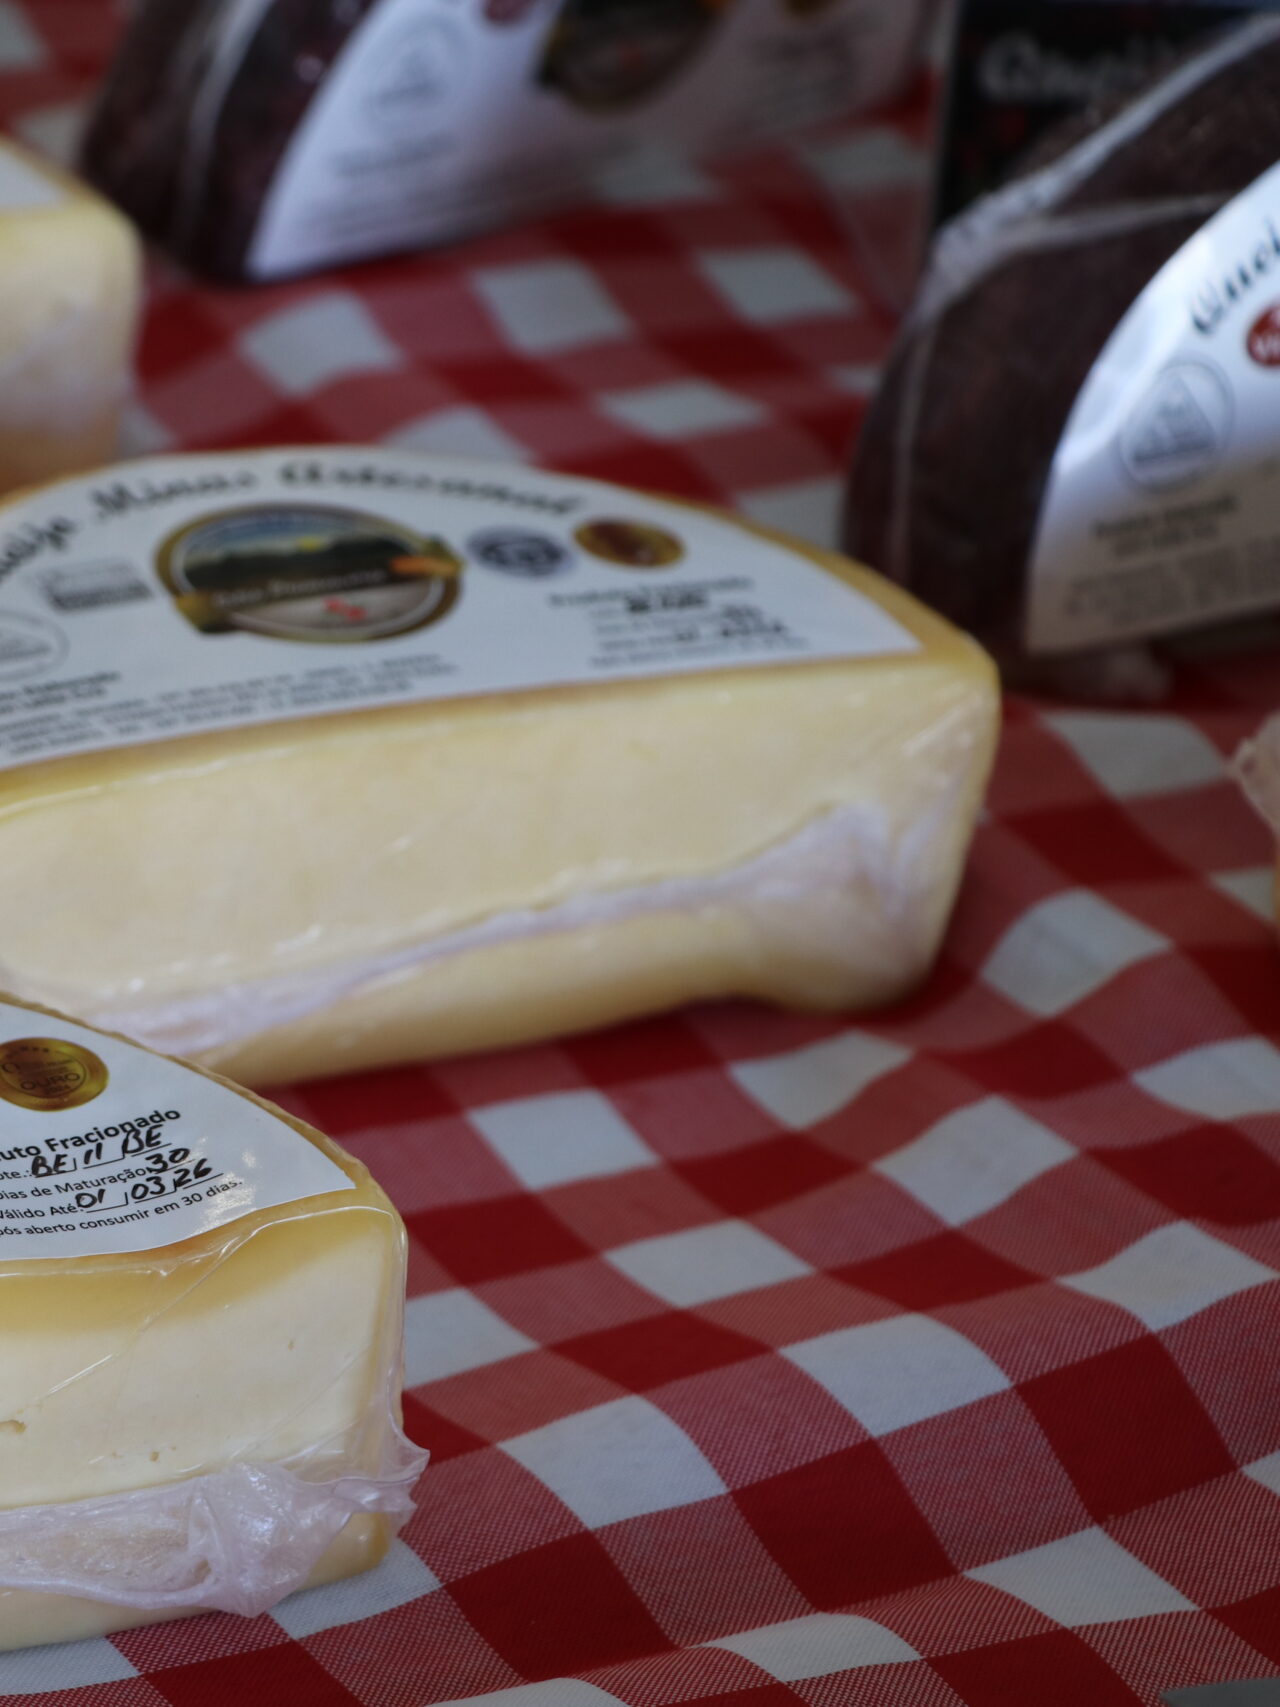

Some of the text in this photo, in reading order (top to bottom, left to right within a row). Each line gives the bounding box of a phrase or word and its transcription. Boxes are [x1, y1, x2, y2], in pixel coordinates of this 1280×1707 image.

[44, 1108, 182, 1153] Fracionado
[145, 1147, 191, 1175] 30
[30, 1184, 53, 1197] de
[130, 1175, 167, 1200] 03
[25, 1217, 76, 1235] aberto
[79, 1208, 150, 1230] consumir
[154, 1203, 180, 1216] em
[181, 1192, 204, 1207] 30
